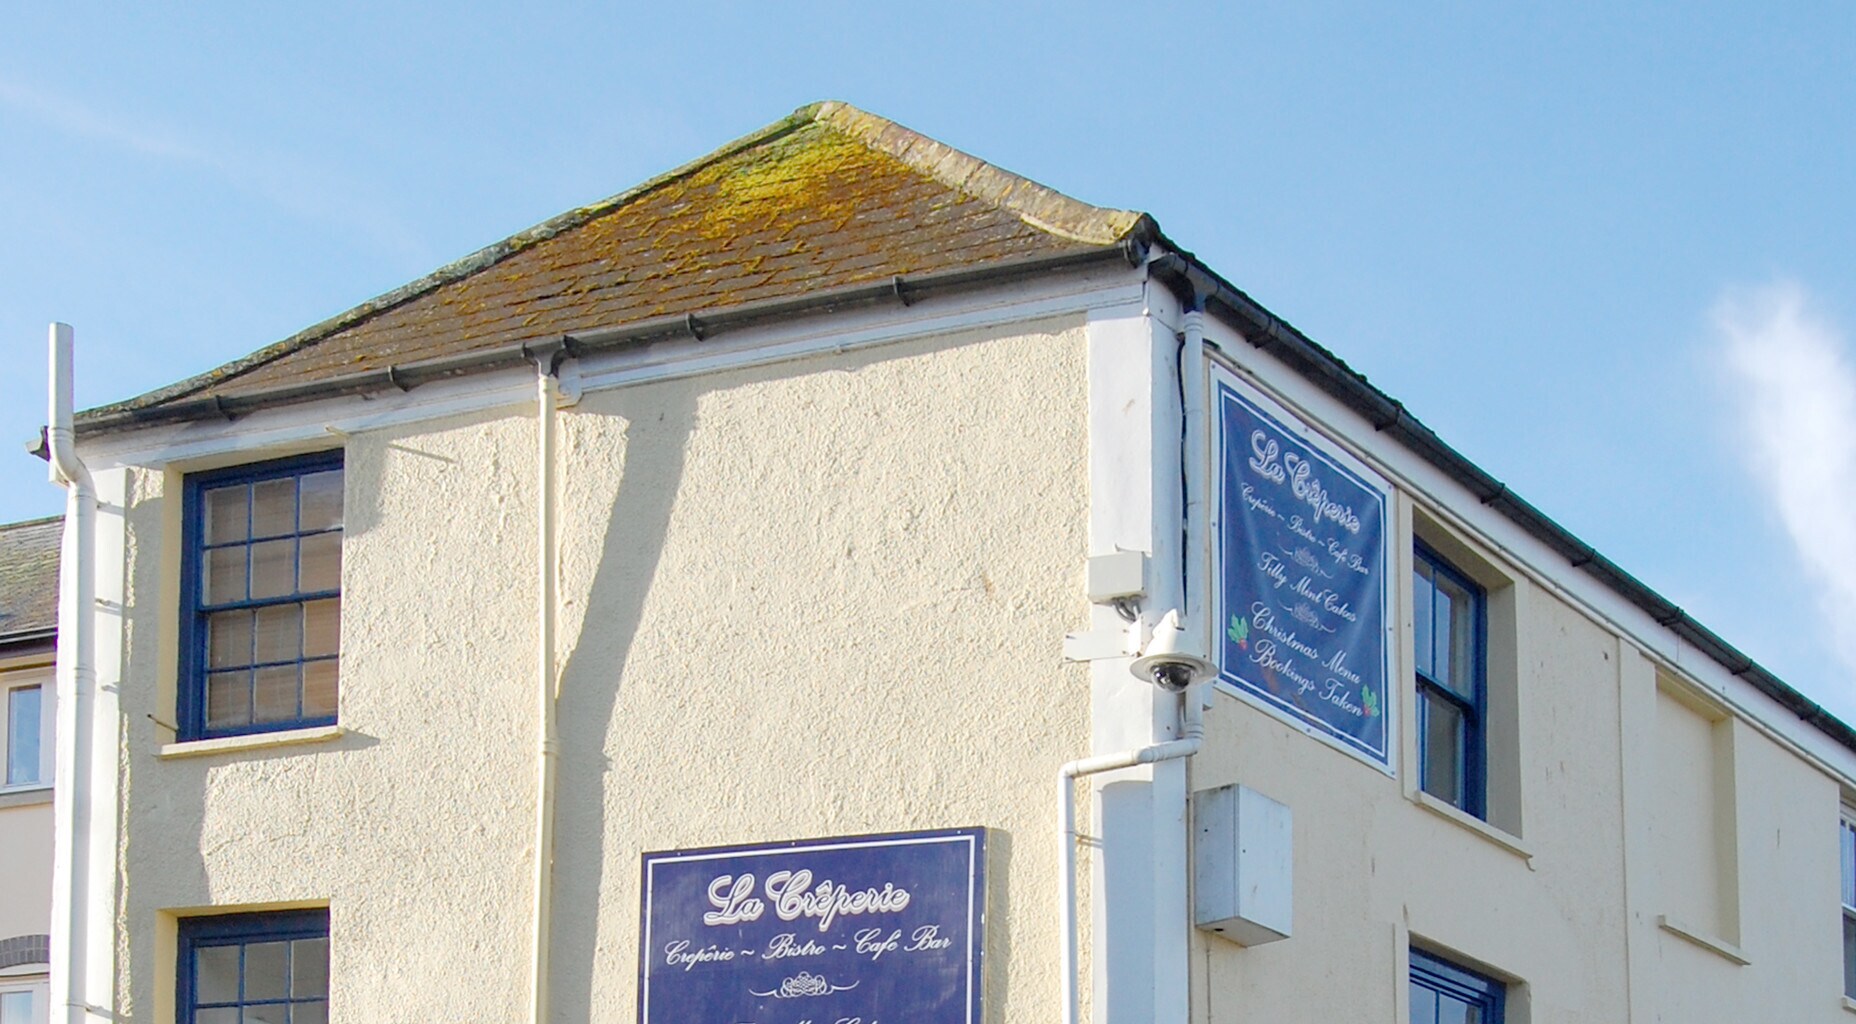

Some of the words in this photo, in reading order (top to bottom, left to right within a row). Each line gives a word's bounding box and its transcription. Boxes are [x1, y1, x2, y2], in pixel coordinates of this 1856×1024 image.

[1249, 430, 1285, 485] La
[1284, 452, 1360, 534] Crêperie
[1257, 552, 1287, 589] Tilly
[1290, 576, 1324, 603] Mint
[1323, 589, 1356, 622] Cakes
[1347, 554, 1369, 575] Bar
[1249, 639, 1316, 695] Bookings
[1319, 678, 1363, 716] Taken
[1251, 602, 1318, 659] Christmas
[1322, 651, 1360, 684] Menu
[703, 872, 765, 925] La
[765, 869, 910, 932] Crêperie
[761, 933, 826, 959] Bistro
[903, 924, 952, 952] Bar
